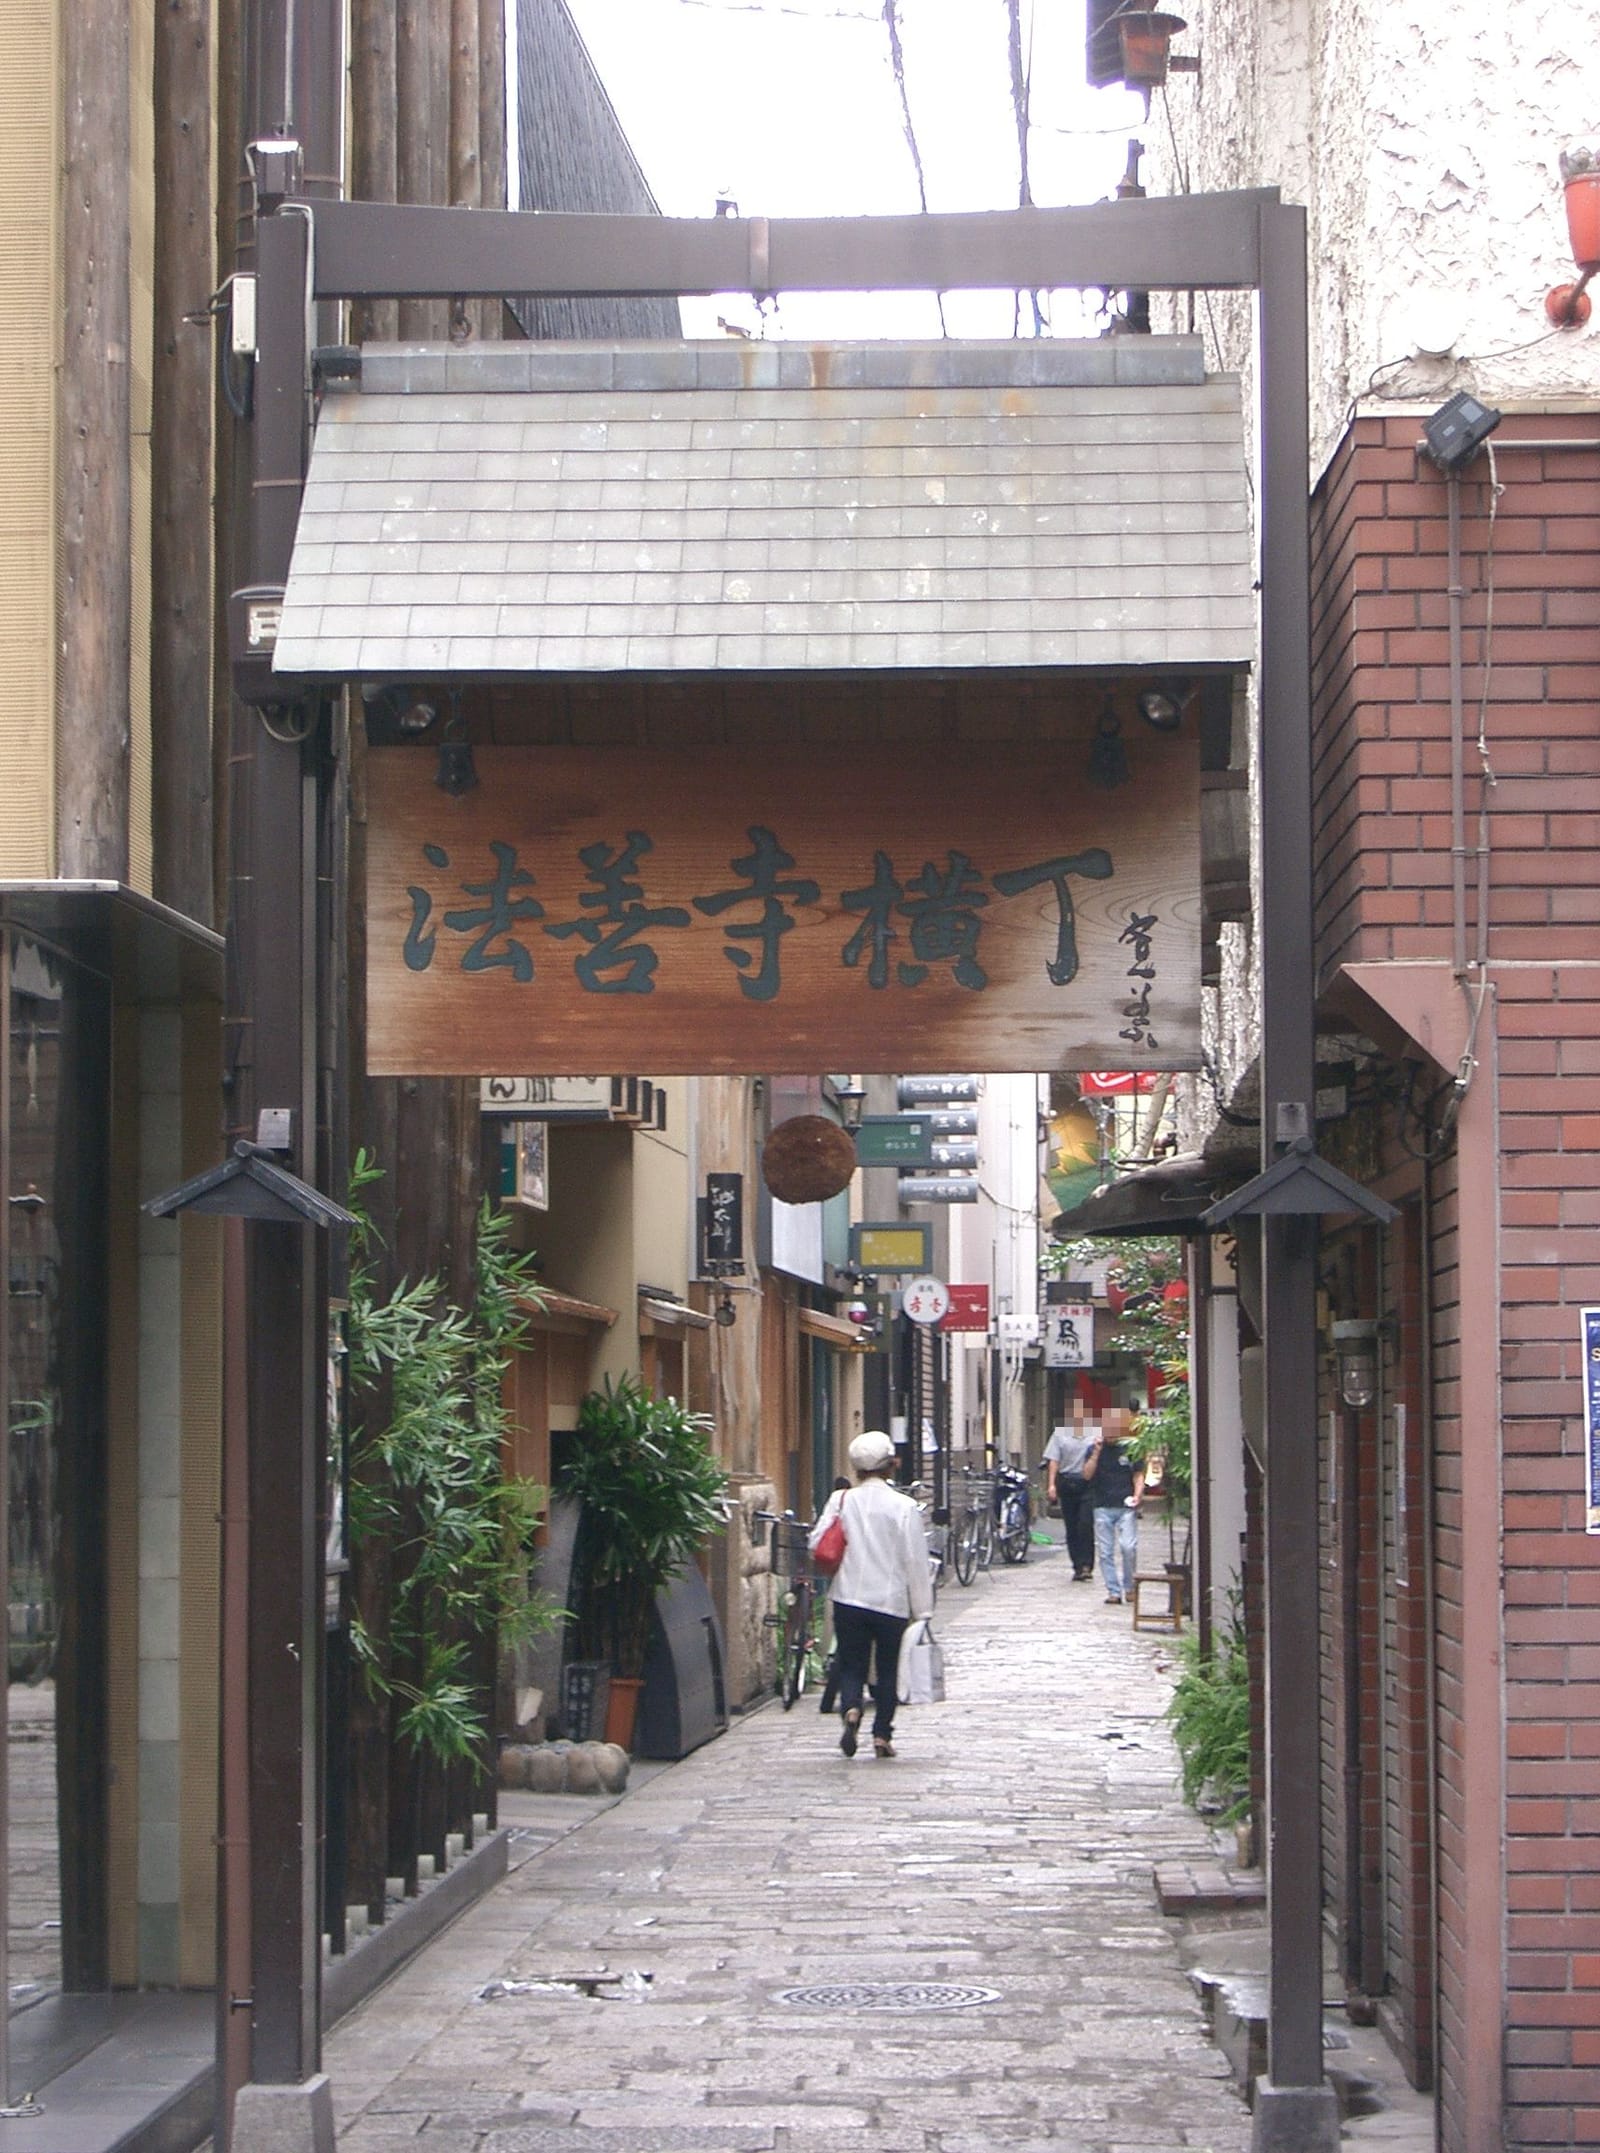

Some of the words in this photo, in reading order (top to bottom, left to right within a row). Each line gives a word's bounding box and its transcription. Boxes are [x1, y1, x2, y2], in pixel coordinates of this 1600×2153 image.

[403, 826, 1114, 1000] 法善寺横丁
